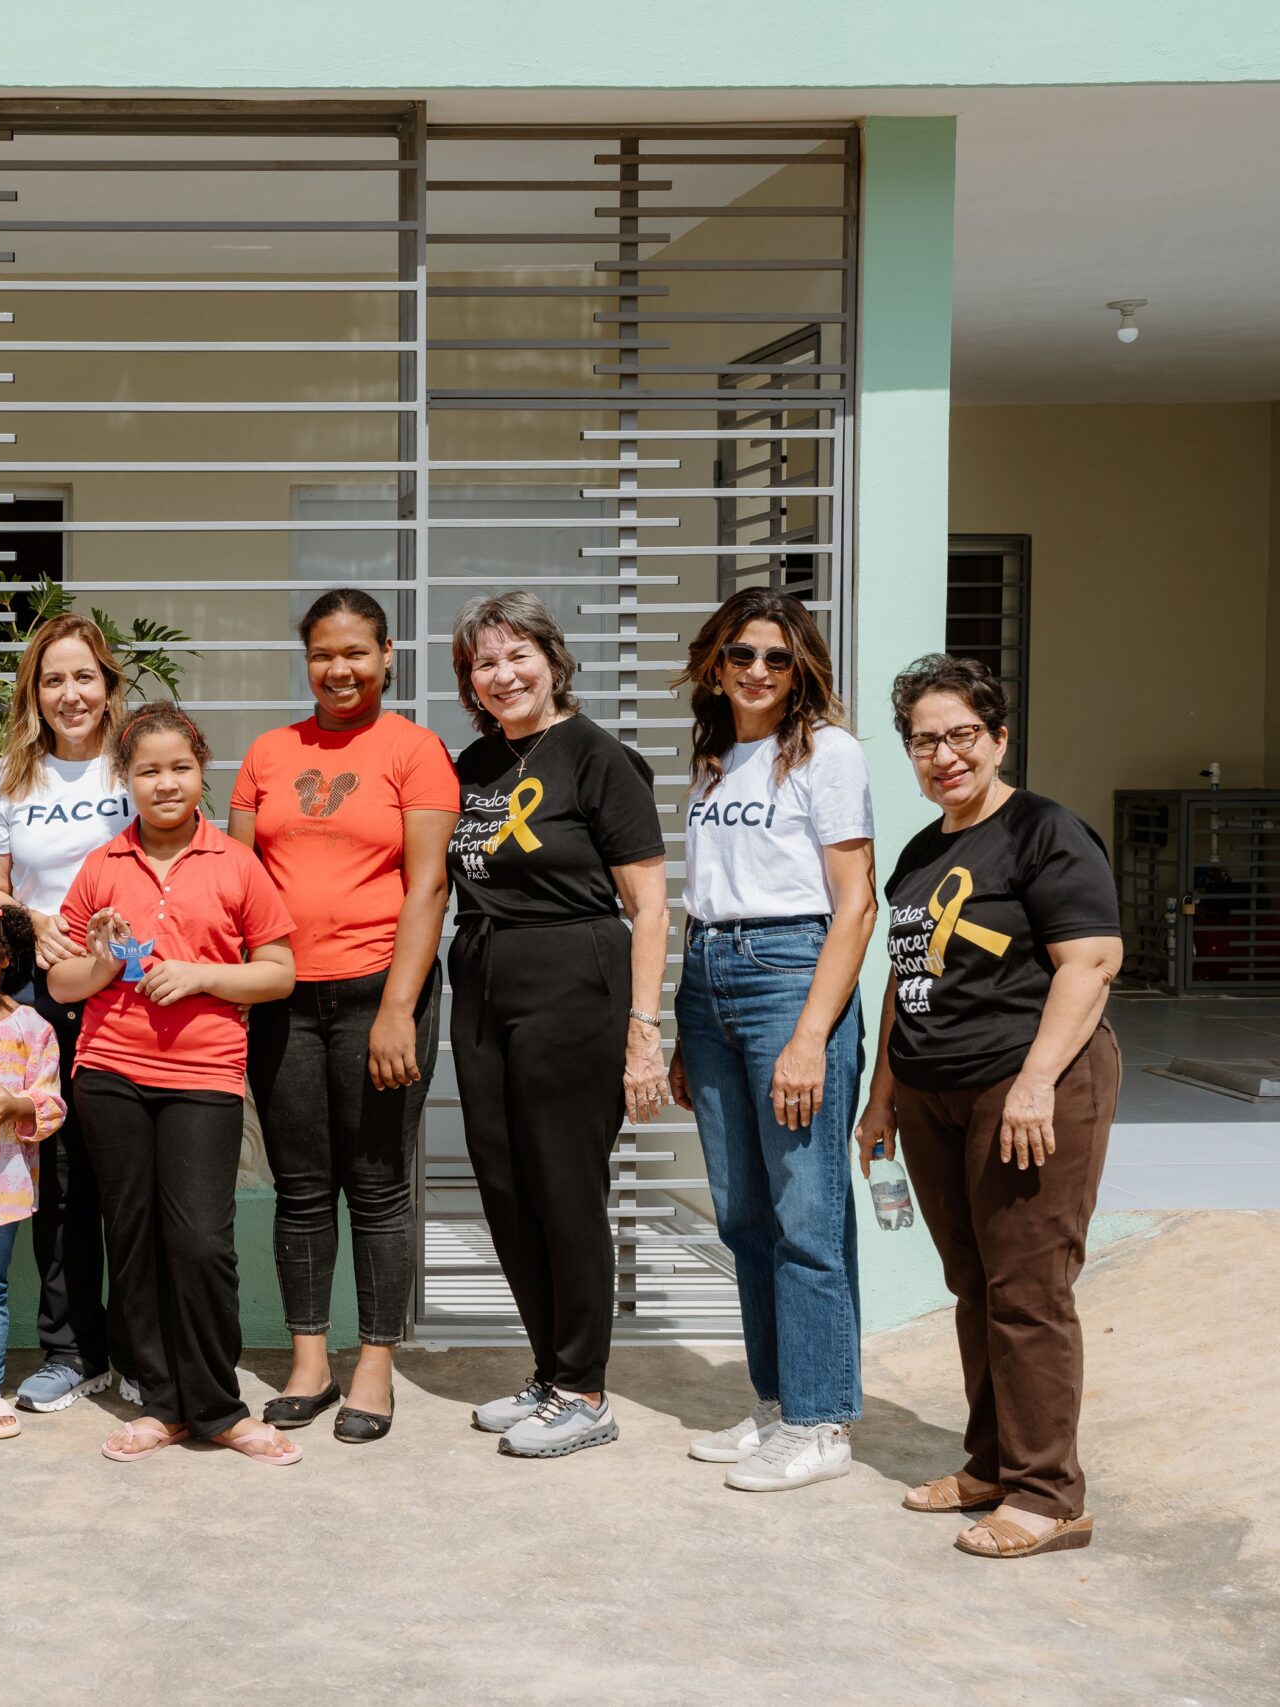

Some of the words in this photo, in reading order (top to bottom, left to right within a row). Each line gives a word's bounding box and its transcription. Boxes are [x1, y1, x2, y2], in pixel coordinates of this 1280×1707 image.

[26, 797, 129, 826] FACCI
[688, 801, 776, 829] FACCI
[454, 819, 510, 834] Cáncer
[467, 871, 491, 880] FACCI
[889, 905, 927, 926] Todos
[921, 919, 935, 931] vs
[888, 933, 932, 956] áncer
[892, 948, 946, 977] nfantil
